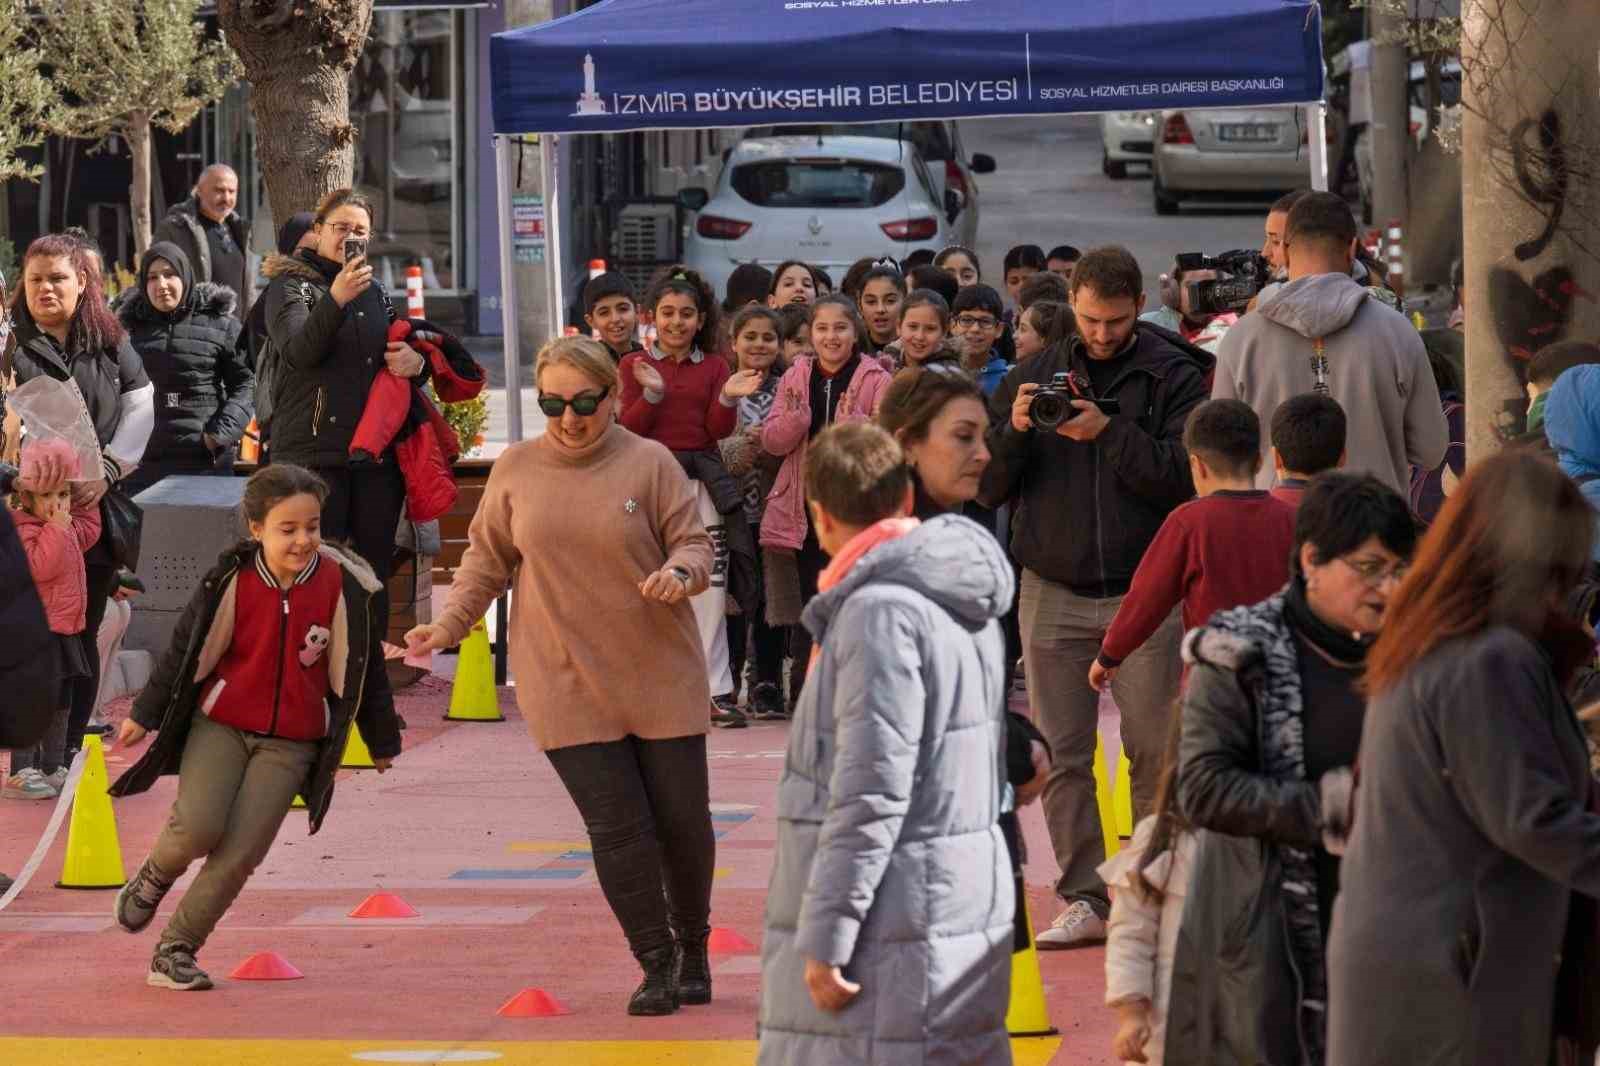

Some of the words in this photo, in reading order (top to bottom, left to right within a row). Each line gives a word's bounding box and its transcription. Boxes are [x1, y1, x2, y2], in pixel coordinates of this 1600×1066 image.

[613, 91, 687, 115] İZMİR
[694, 84, 860, 113] BÜYÜKŞEHİR
[868, 78, 1018, 106] BELEDİYESİ
[1039, 87, 1088, 100] SOSYAL
[1161, 80, 1208, 94] DAİRESİ
